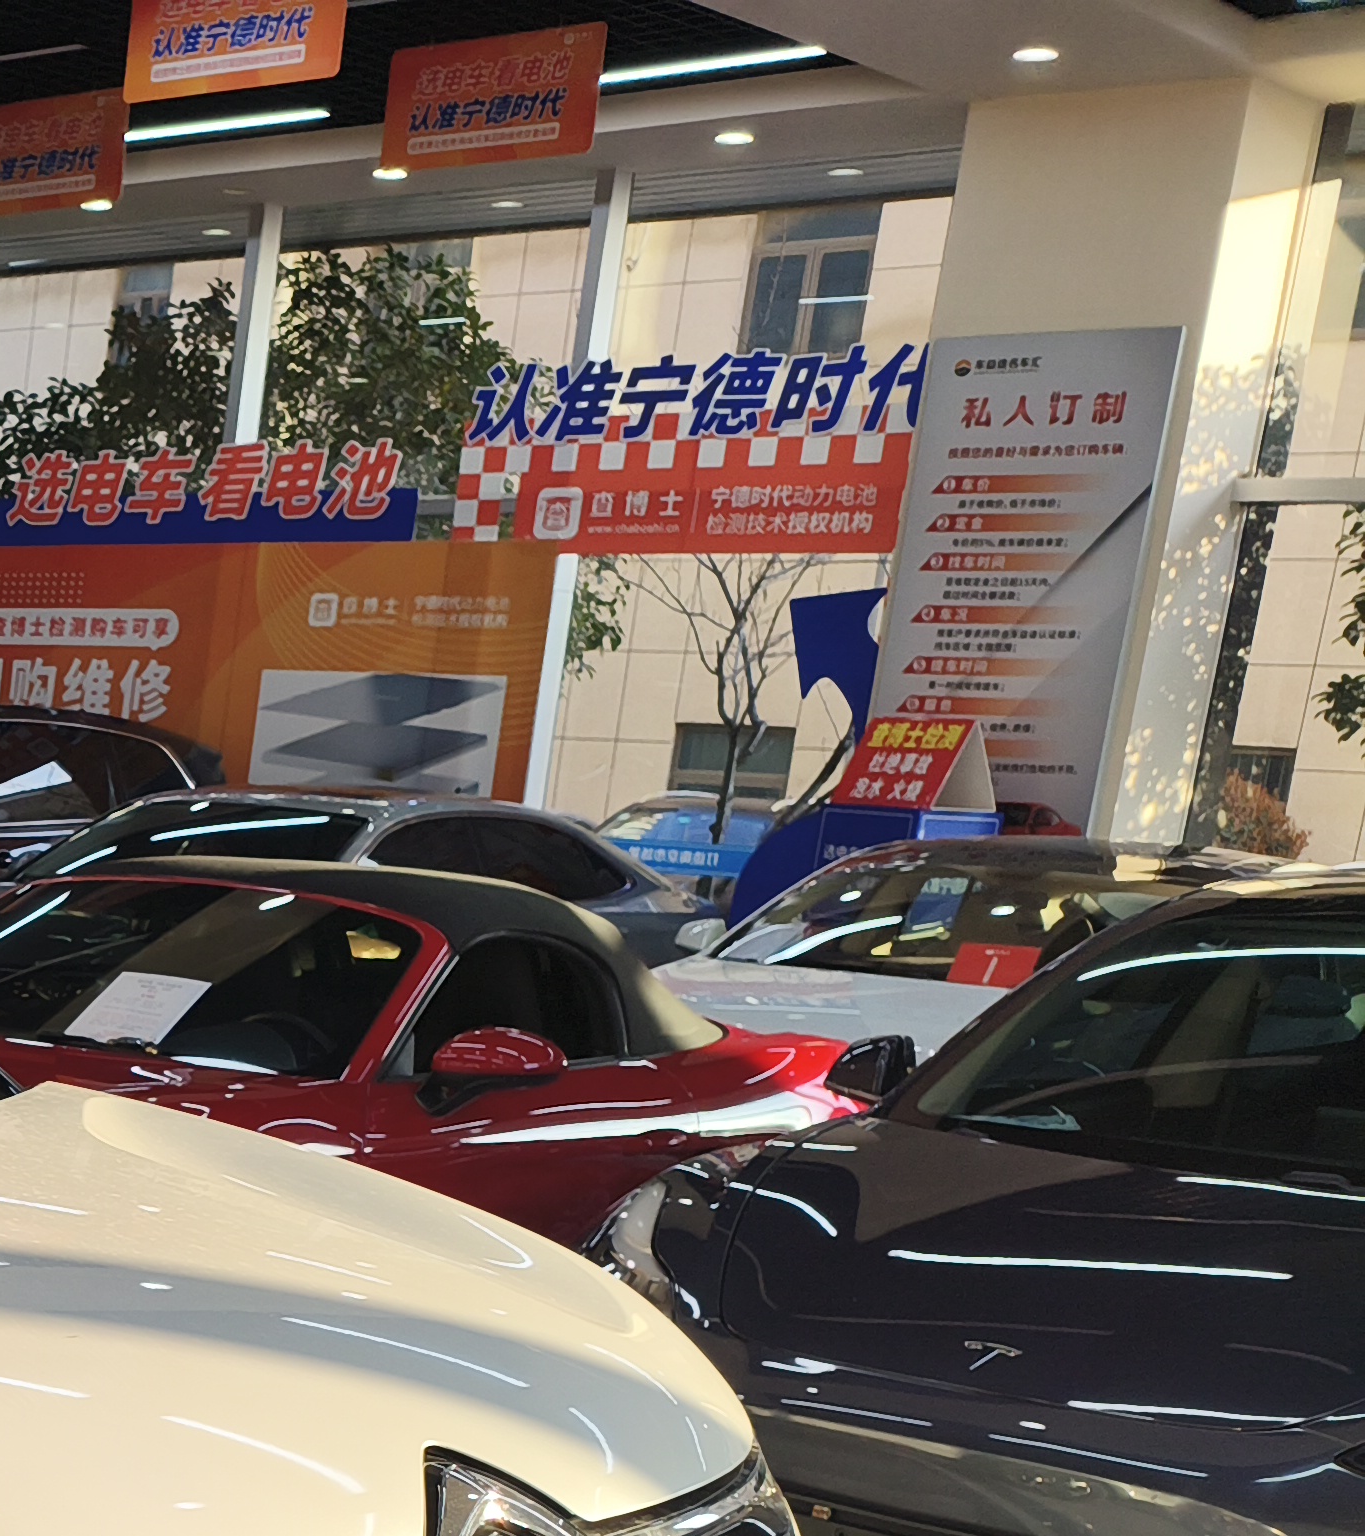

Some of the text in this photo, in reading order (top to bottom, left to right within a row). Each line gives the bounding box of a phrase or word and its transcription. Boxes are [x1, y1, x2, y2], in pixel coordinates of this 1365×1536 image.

[151, 6, 313, 60] 认准宁德时代
[413, 50, 574, 98] 选电车看电池
[409, 87, 567, 132] 认准宁德时代
[468, 343, 930, 444] 认准宁德时代
[960, 390, 1128, 429] 私人订制
[7, 437, 403, 527] 选电车看电池
[710, 484, 878, 509] 宁德时代动力电池
[590, 489, 684, 519] 查博士
[705, 511, 874, 536] 检测技术授权机构
[867, 721, 966, 751] 查博士检测
